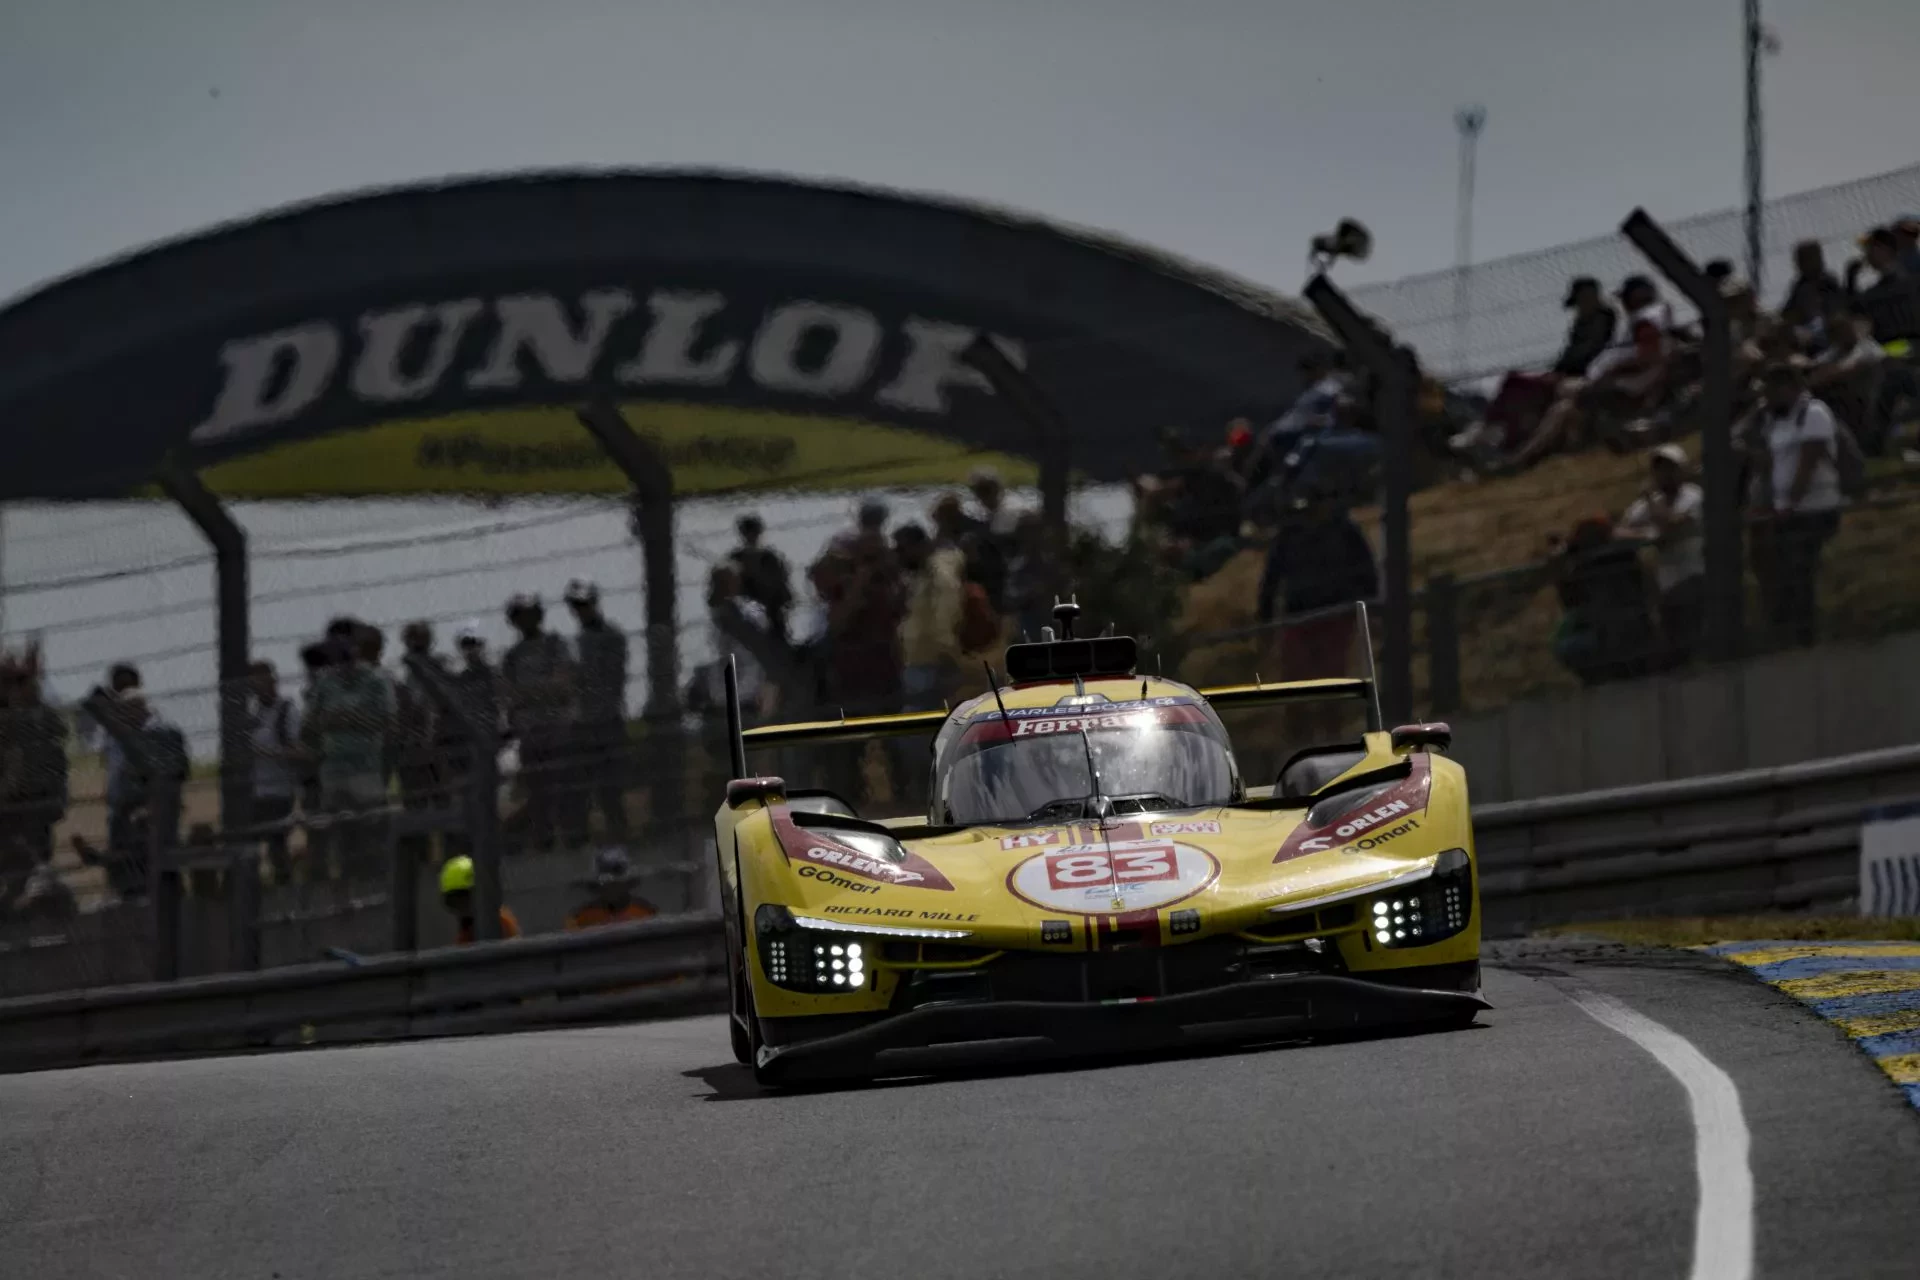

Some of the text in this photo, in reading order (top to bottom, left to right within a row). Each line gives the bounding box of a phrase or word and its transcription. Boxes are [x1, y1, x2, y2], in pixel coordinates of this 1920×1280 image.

[987, 705, 1080, 719] CHARLES
[1012, 709, 1155, 738] Ferra
[1336, 799, 1410, 837] ORLEN
[1341, 818, 1421, 855] GOmart
[807, 847, 887, 876] ORLEN
[1055, 850, 1170, 883] 83
[798, 866, 881, 894] GOmart
[824, 905, 981, 922] RICHARD MILLE
